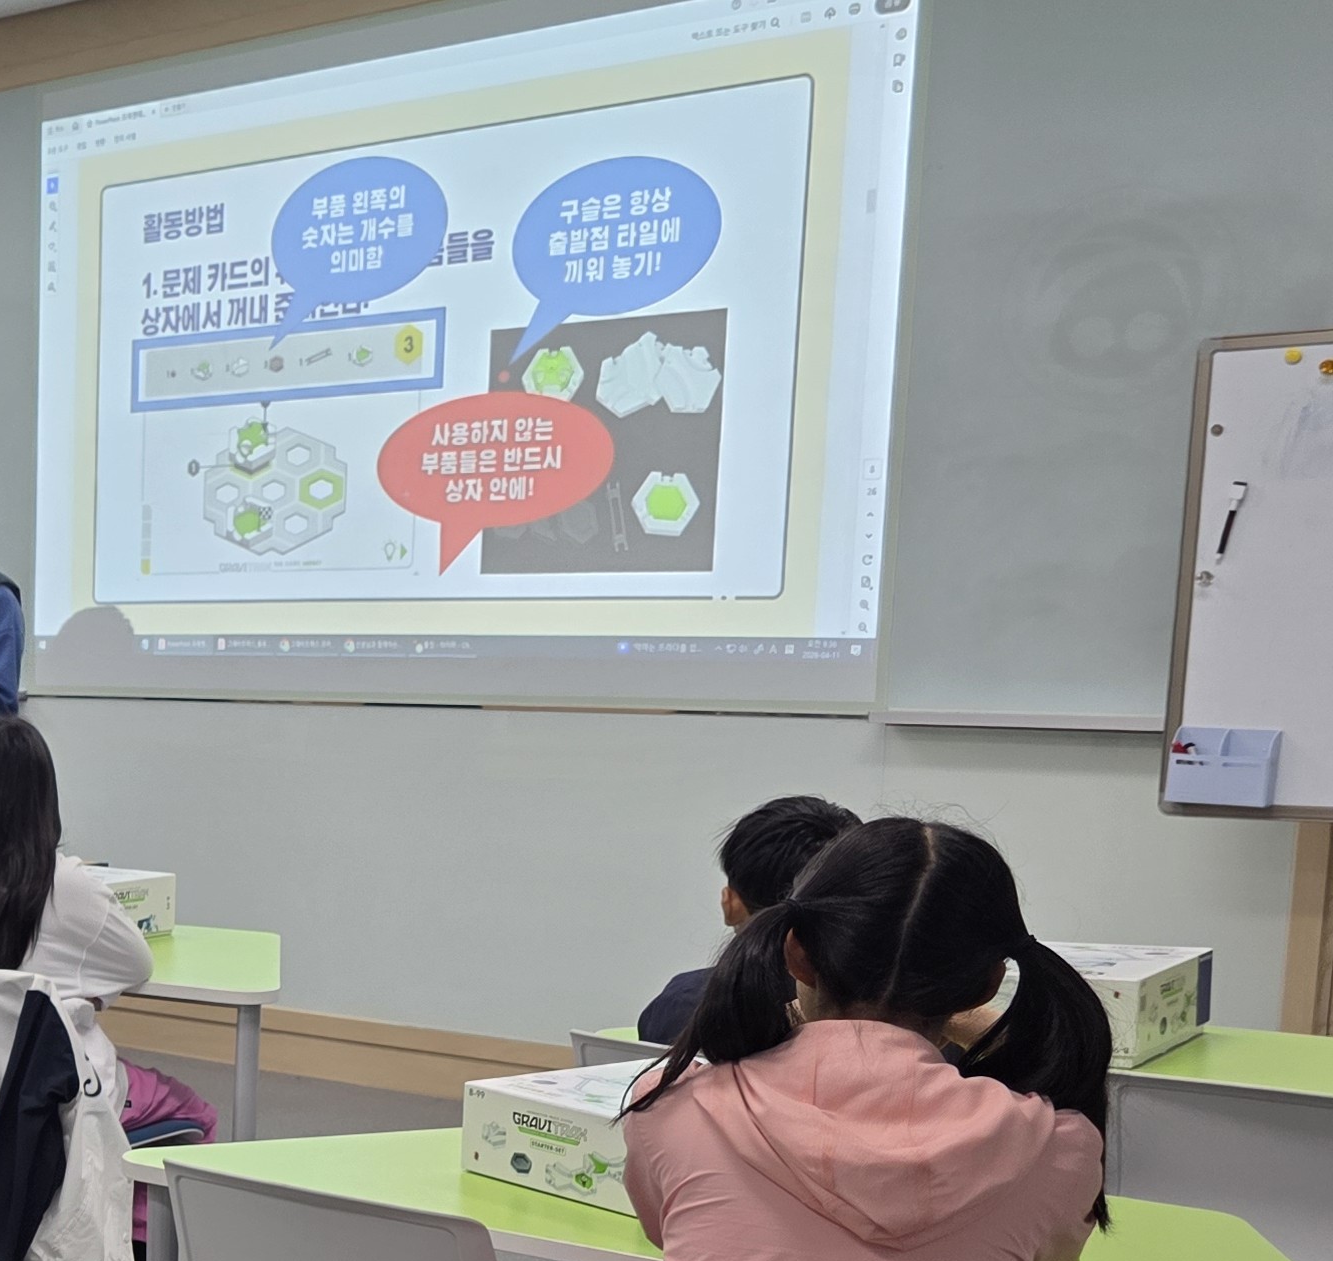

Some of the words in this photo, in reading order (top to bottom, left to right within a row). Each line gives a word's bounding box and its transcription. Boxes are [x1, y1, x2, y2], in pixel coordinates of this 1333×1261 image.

[311, 194, 346, 220] 부품
[352, 185, 406, 212] 왼쪽의
[559, 193, 622, 224] 구슬은
[629, 186, 672, 216] 항상
[143, 202, 225, 244] 활동방법
[301, 223, 354, 250] 숫자는
[360, 213, 415, 240] 개수를
[548, 225, 610, 257] 출발점
[616, 216, 681, 248] 타일에
[329, 246, 383, 273] 의미함
[563, 256, 605, 284] 끼워
[611, 250, 662, 280] 놓기!
[141, 271, 159, 299] 1.
[161, 263, 202, 299] 문제
[206, 256, 270, 292] 카드의
[141, 299, 222, 337] 상자에서
[227, 293, 269, 327] 꺼내
[403, 335, 414, 353] 3
[431, 418, 508, 446] 사용하지
[513, 417, 554, 442] 않는
[421, 449, 497, 475] 부품들은
[503, 445, 562, 472] 반드시
[445, 478, 483, 503] 상자
[489, 476, 535, 501] 안에!
